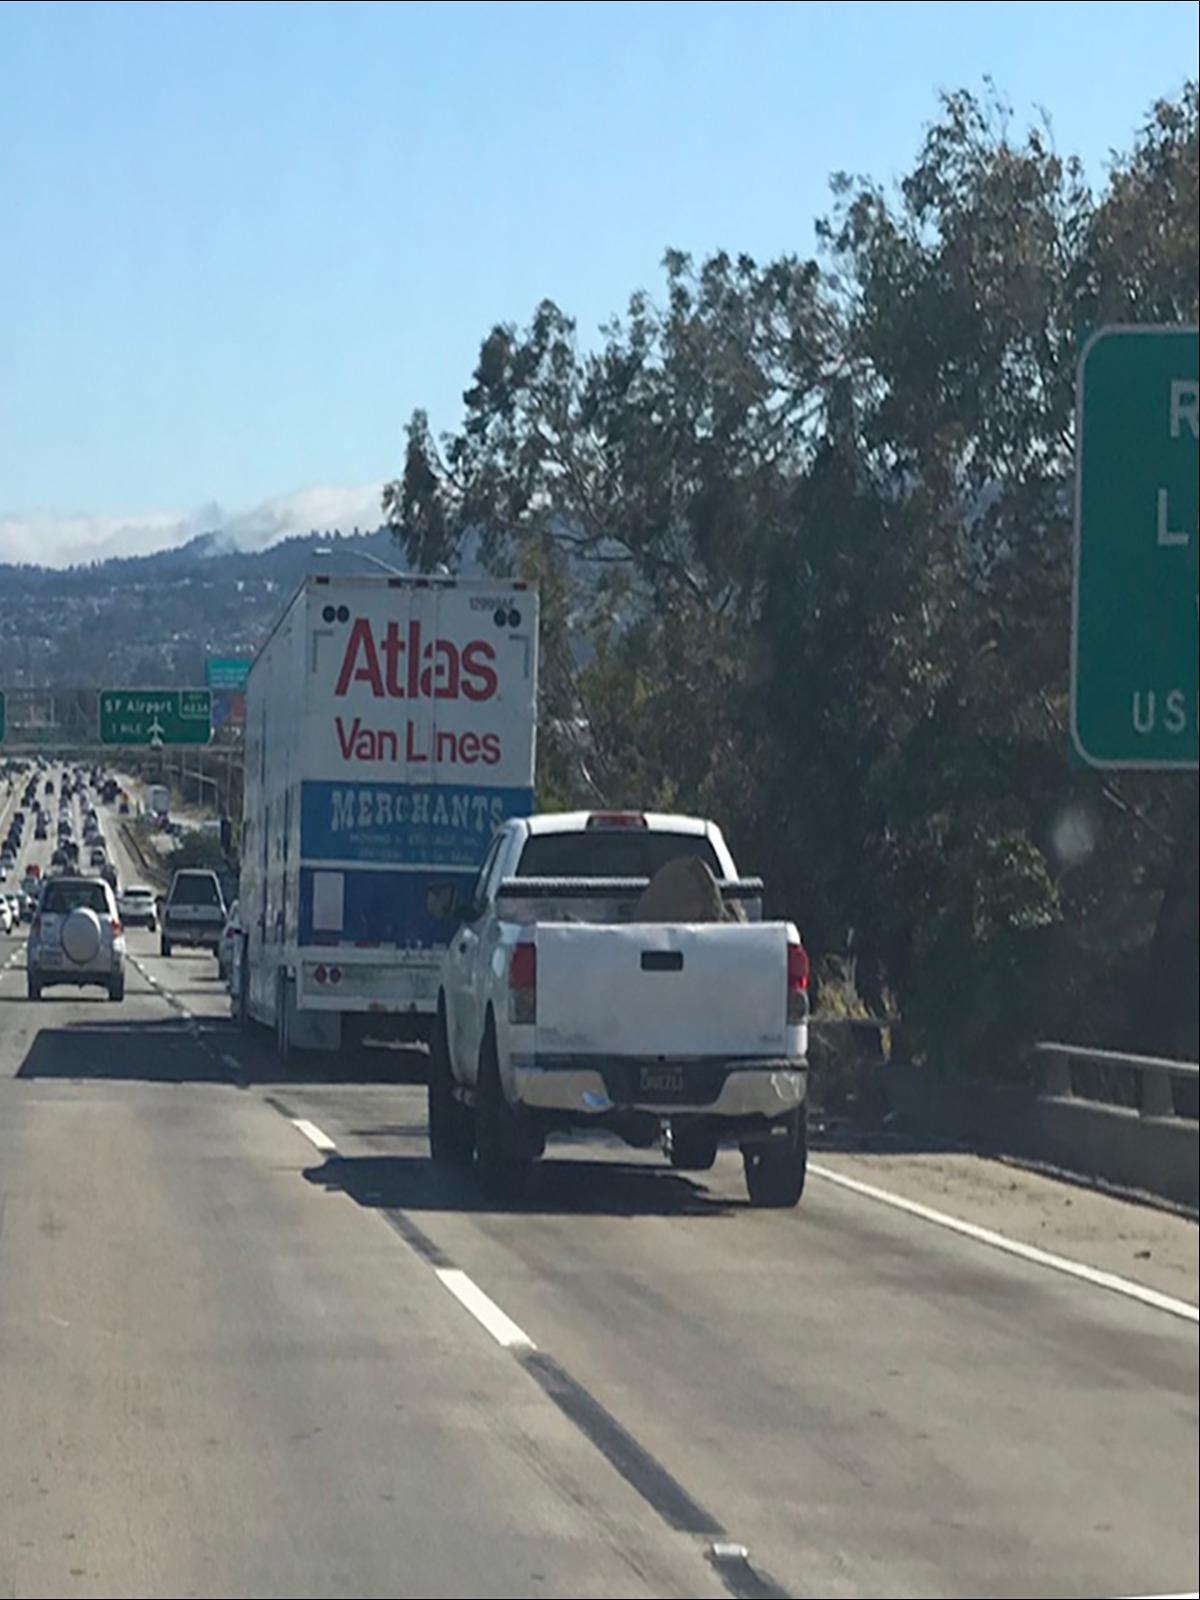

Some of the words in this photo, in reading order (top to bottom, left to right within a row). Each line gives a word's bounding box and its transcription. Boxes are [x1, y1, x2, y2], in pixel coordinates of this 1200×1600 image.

[335, 618, 498, 702] Atlas
[105, 699, 121, 713] SF
[126, 699, 172, 715] Airport
[335, 716, 398, 762] Van
[406, 719, 502, 765] Lnes
[331, 789, 504, 834] MERCHANTS
